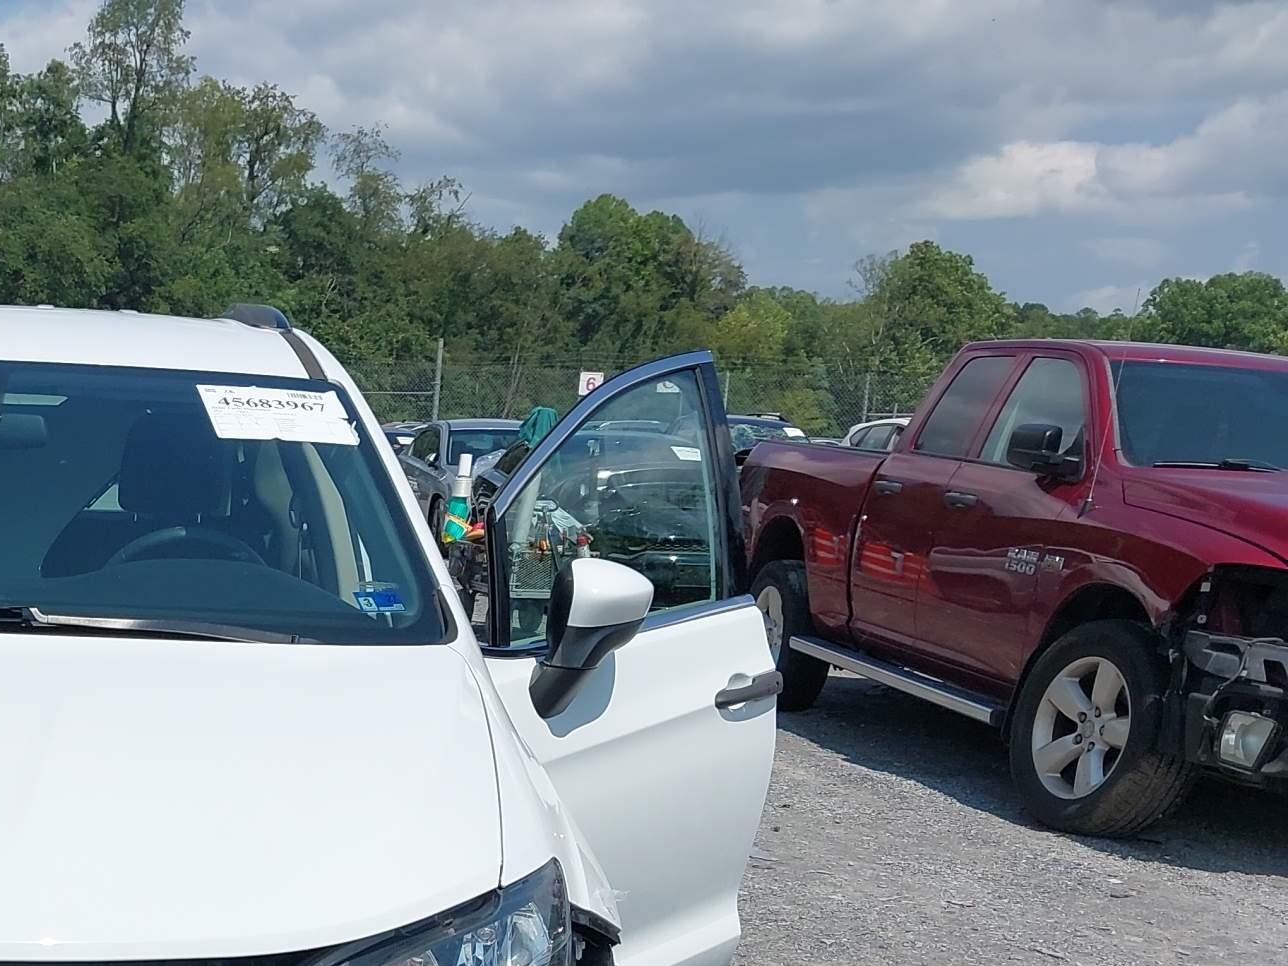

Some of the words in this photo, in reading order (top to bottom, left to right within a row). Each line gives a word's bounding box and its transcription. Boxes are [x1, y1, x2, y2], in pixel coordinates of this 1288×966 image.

[585, 376, 597, 392] 6
[217, 396, 325, 413] 45683967
[1004, 560, 1036, 576] 1500
